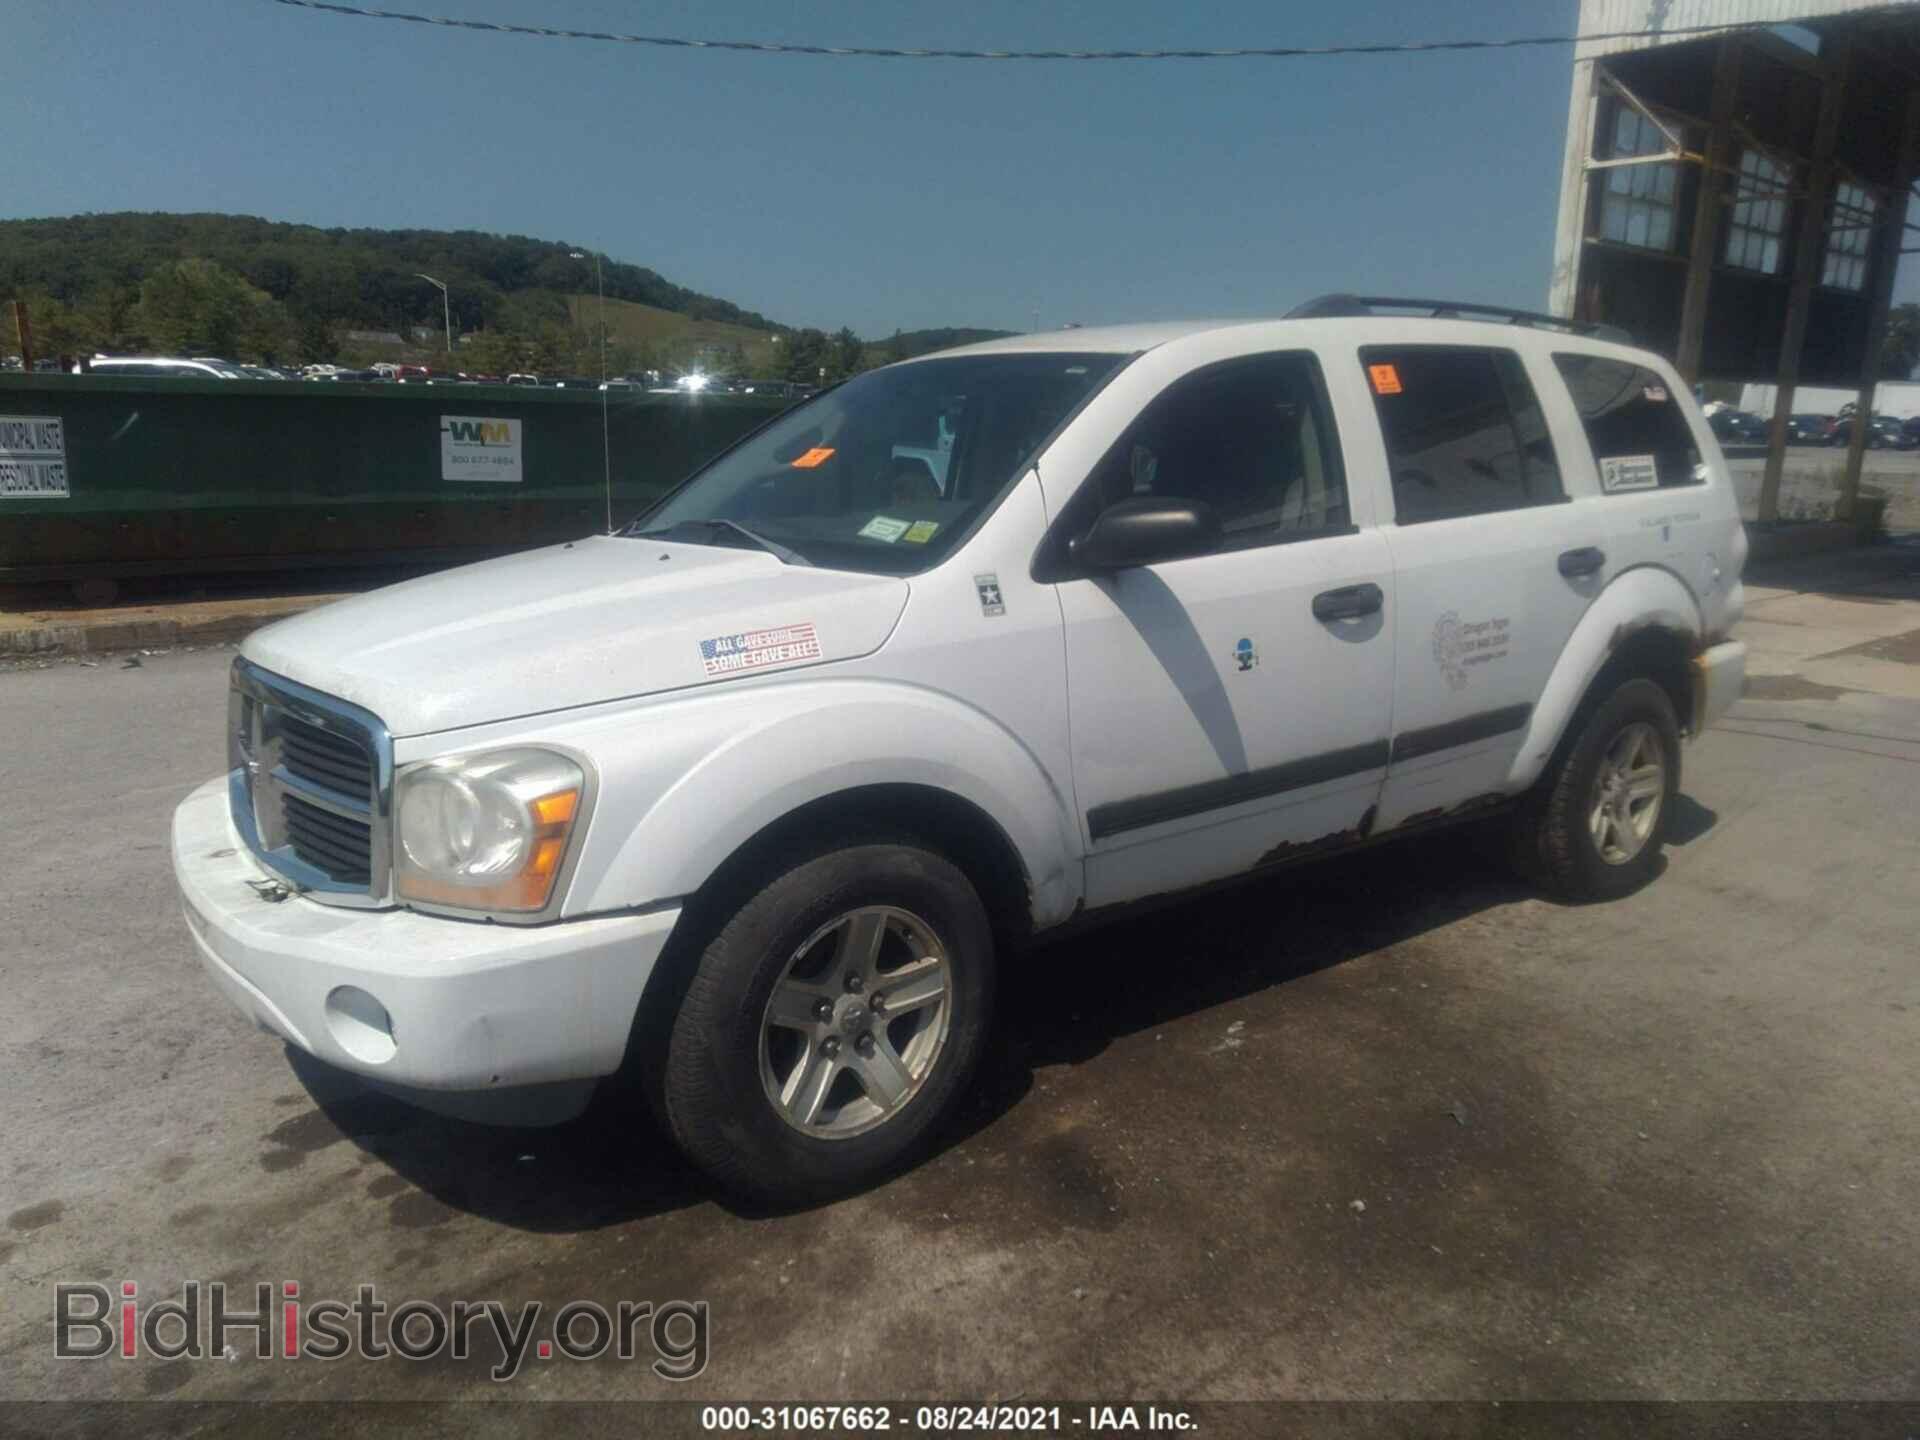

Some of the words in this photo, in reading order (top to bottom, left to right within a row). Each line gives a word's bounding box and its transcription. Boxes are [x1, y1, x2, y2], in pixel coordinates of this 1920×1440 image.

[36, 423, 60, 450] WASTE
[449, 421, 512, 443] WM
[40, 464, 66, 491] WASTE
[715, 637, 734, 653] ALL
[738, 632, 763, 650] GAVE
[713, 653, 745, 671] SOME
[752, 646, 785, 664] GAVE
